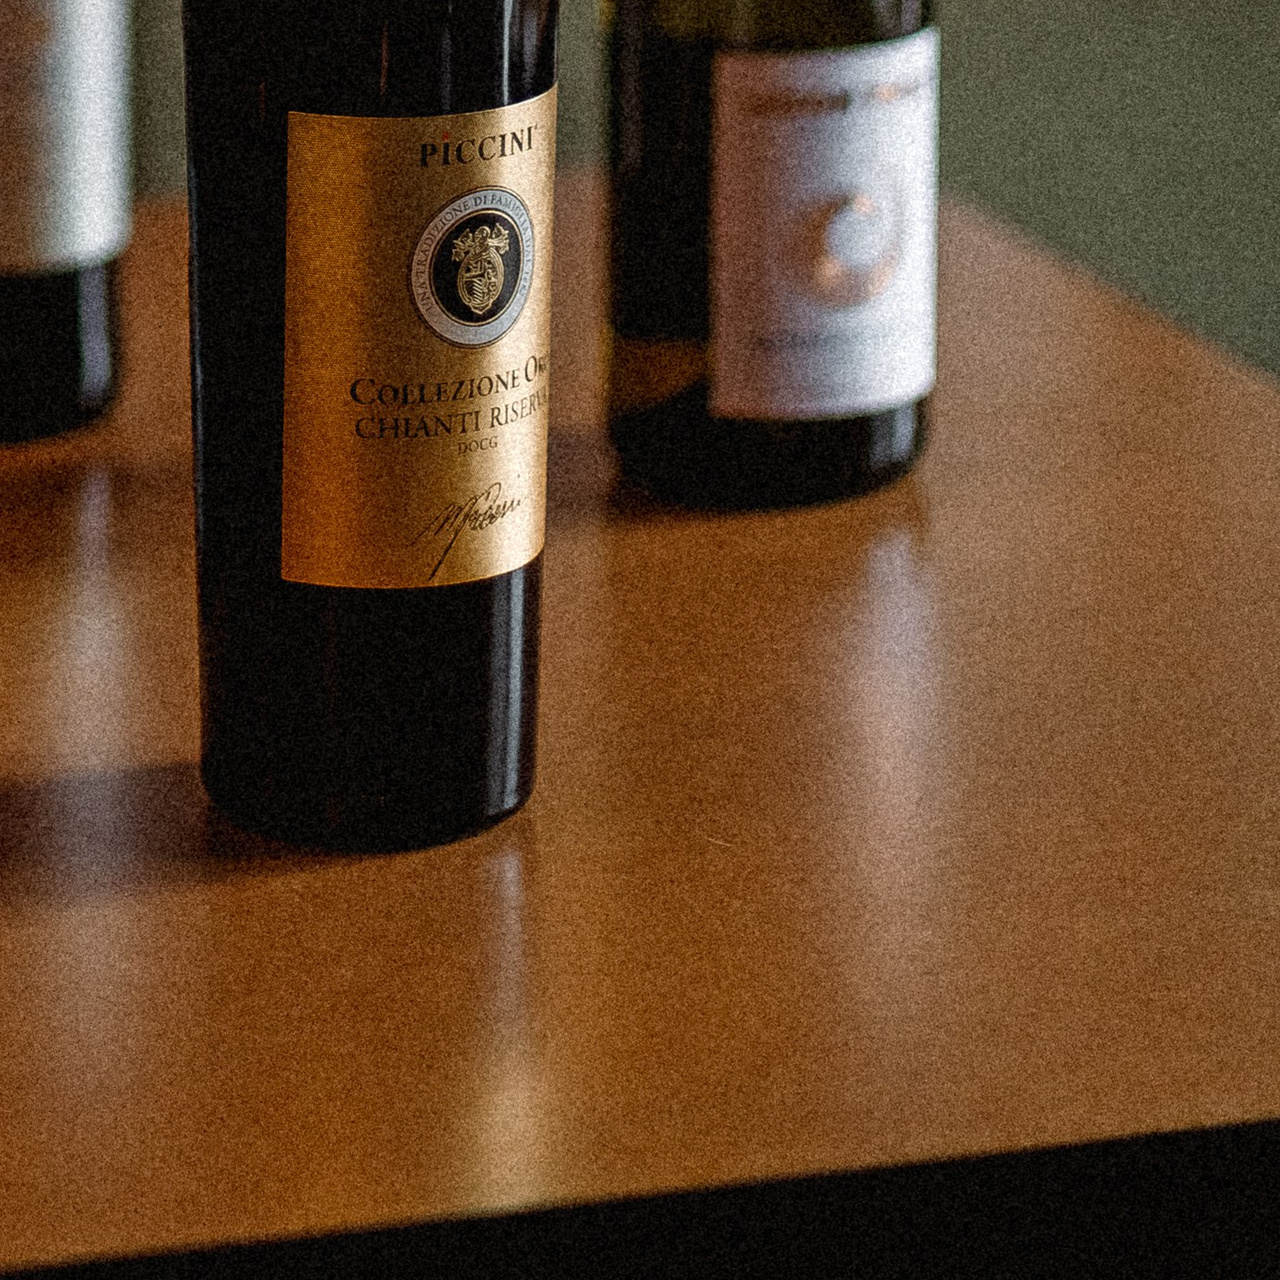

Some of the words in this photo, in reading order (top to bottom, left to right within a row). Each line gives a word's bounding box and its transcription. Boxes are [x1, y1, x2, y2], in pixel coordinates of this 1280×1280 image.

[420, 126, 534, 167] PICCINI
[473, 195, 487, 208] DI
[415, 201, 470, 281] TRADIZIONE
[417, 282, 433, 311] UNA
[350, 368, 520, 405] COLLEZIONE
[355, 410, 480, 439] CHIANTI
[458, 436, 498, 455] DOCG
